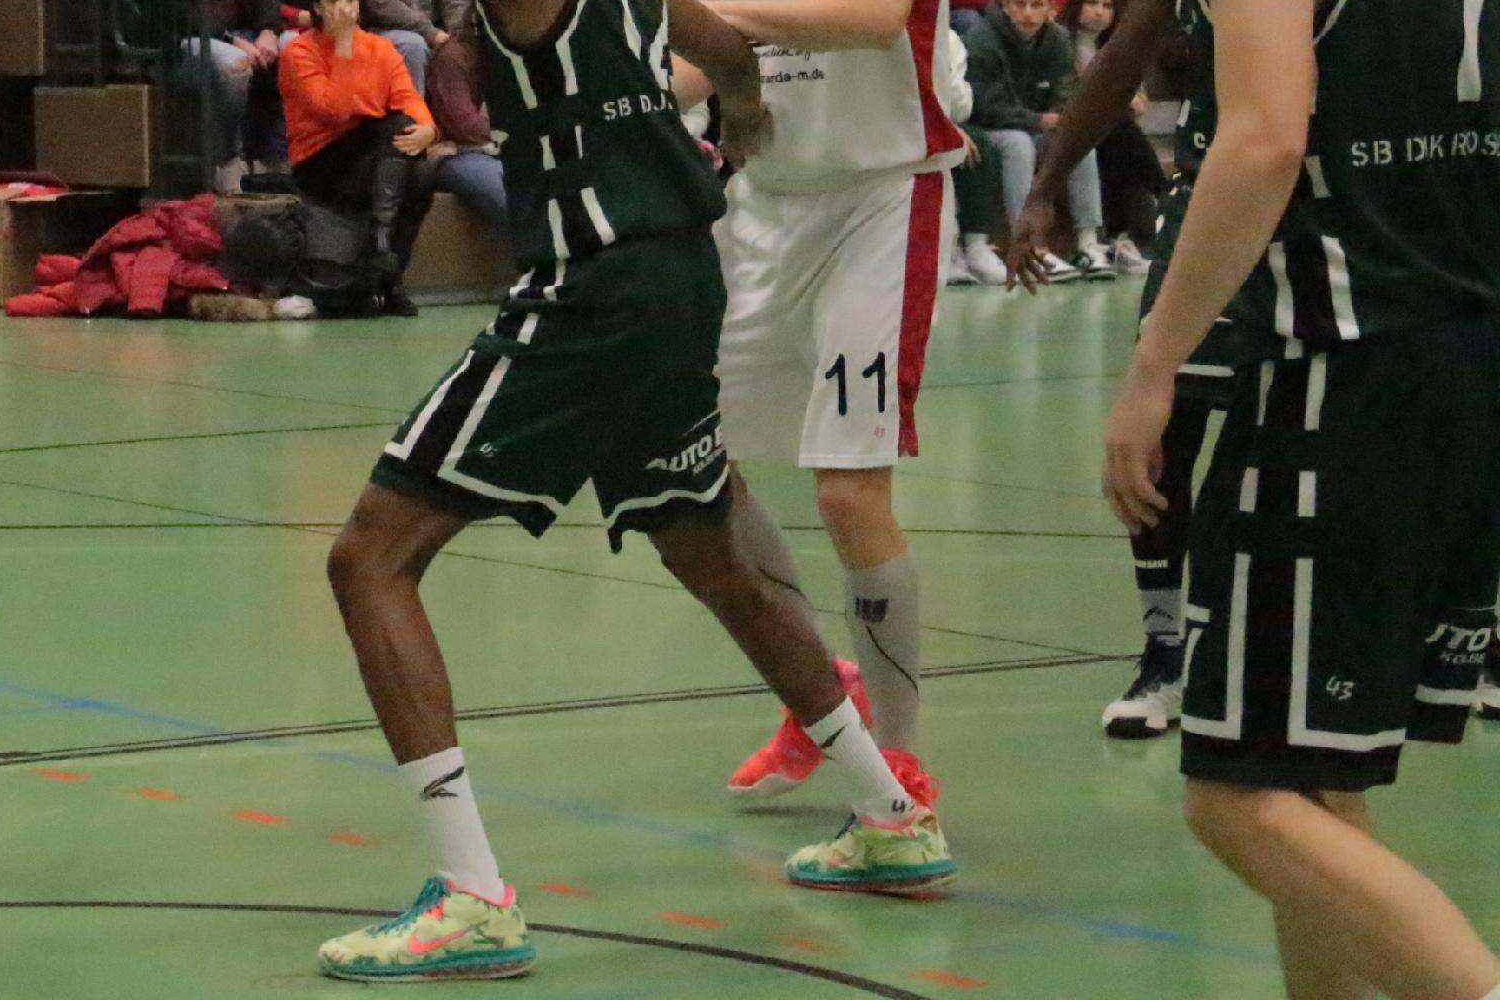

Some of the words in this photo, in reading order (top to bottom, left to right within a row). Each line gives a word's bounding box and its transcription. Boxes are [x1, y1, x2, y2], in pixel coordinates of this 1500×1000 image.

[603, 96, 633, 121] SB
[1351, 140, 1393, 167] SB
[825, 352, 887, 416] 11
